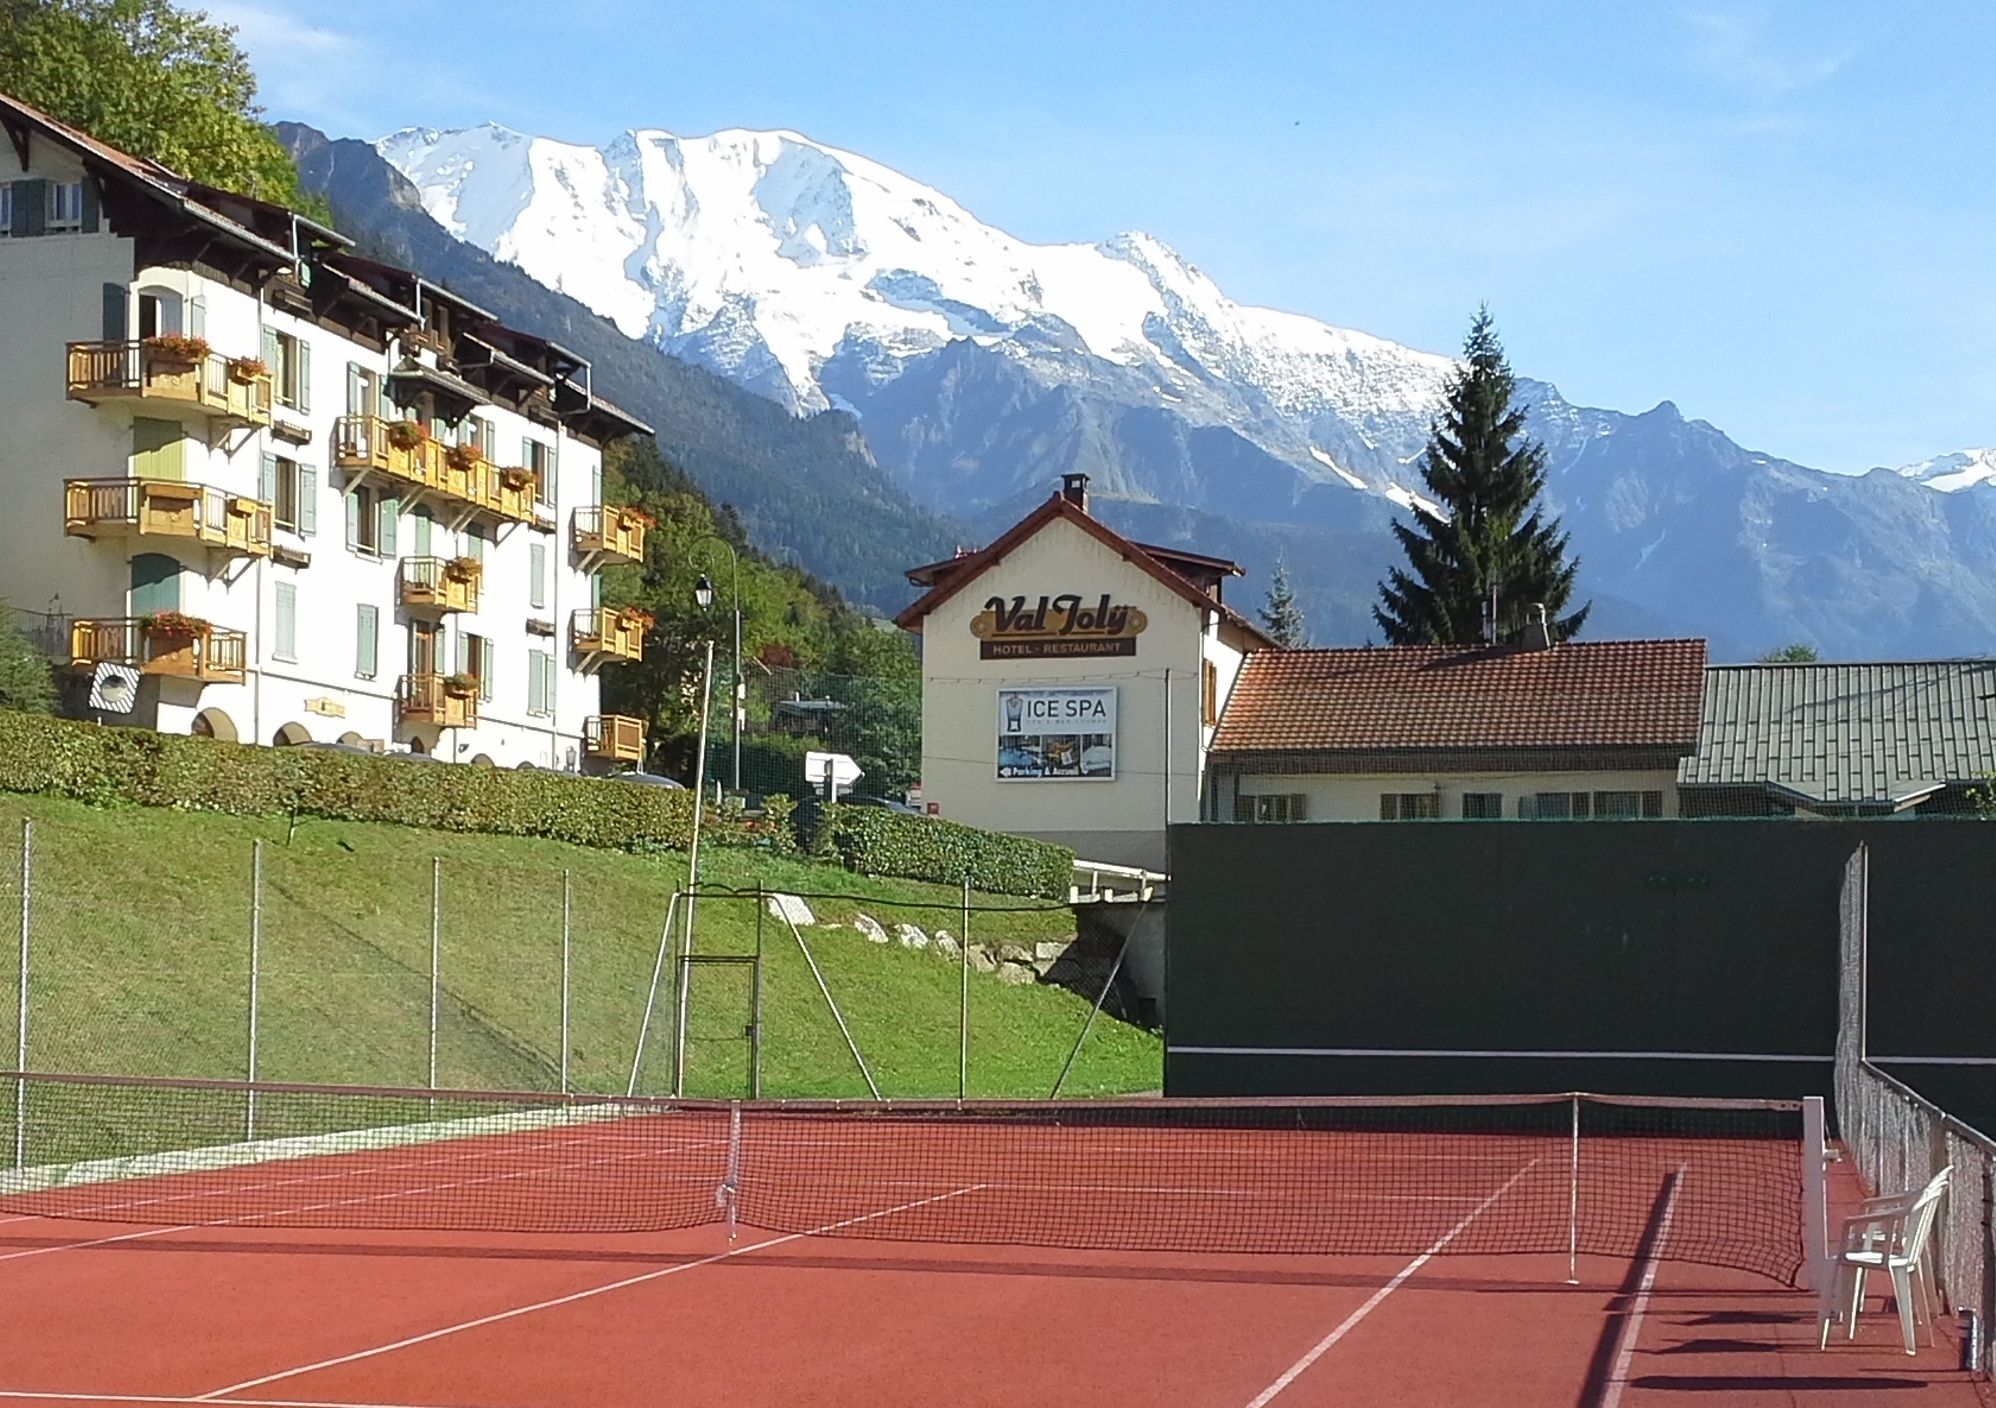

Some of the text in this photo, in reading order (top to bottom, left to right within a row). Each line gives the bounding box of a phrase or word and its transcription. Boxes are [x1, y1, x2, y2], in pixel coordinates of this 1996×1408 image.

[984, 595, 1049, 632] Val
[993, 644, 1032, 655] HOTEL
[1043, 642, 1121, 654] RESTAURANT
[1027, 699, 1106, 717] ICE SPA
